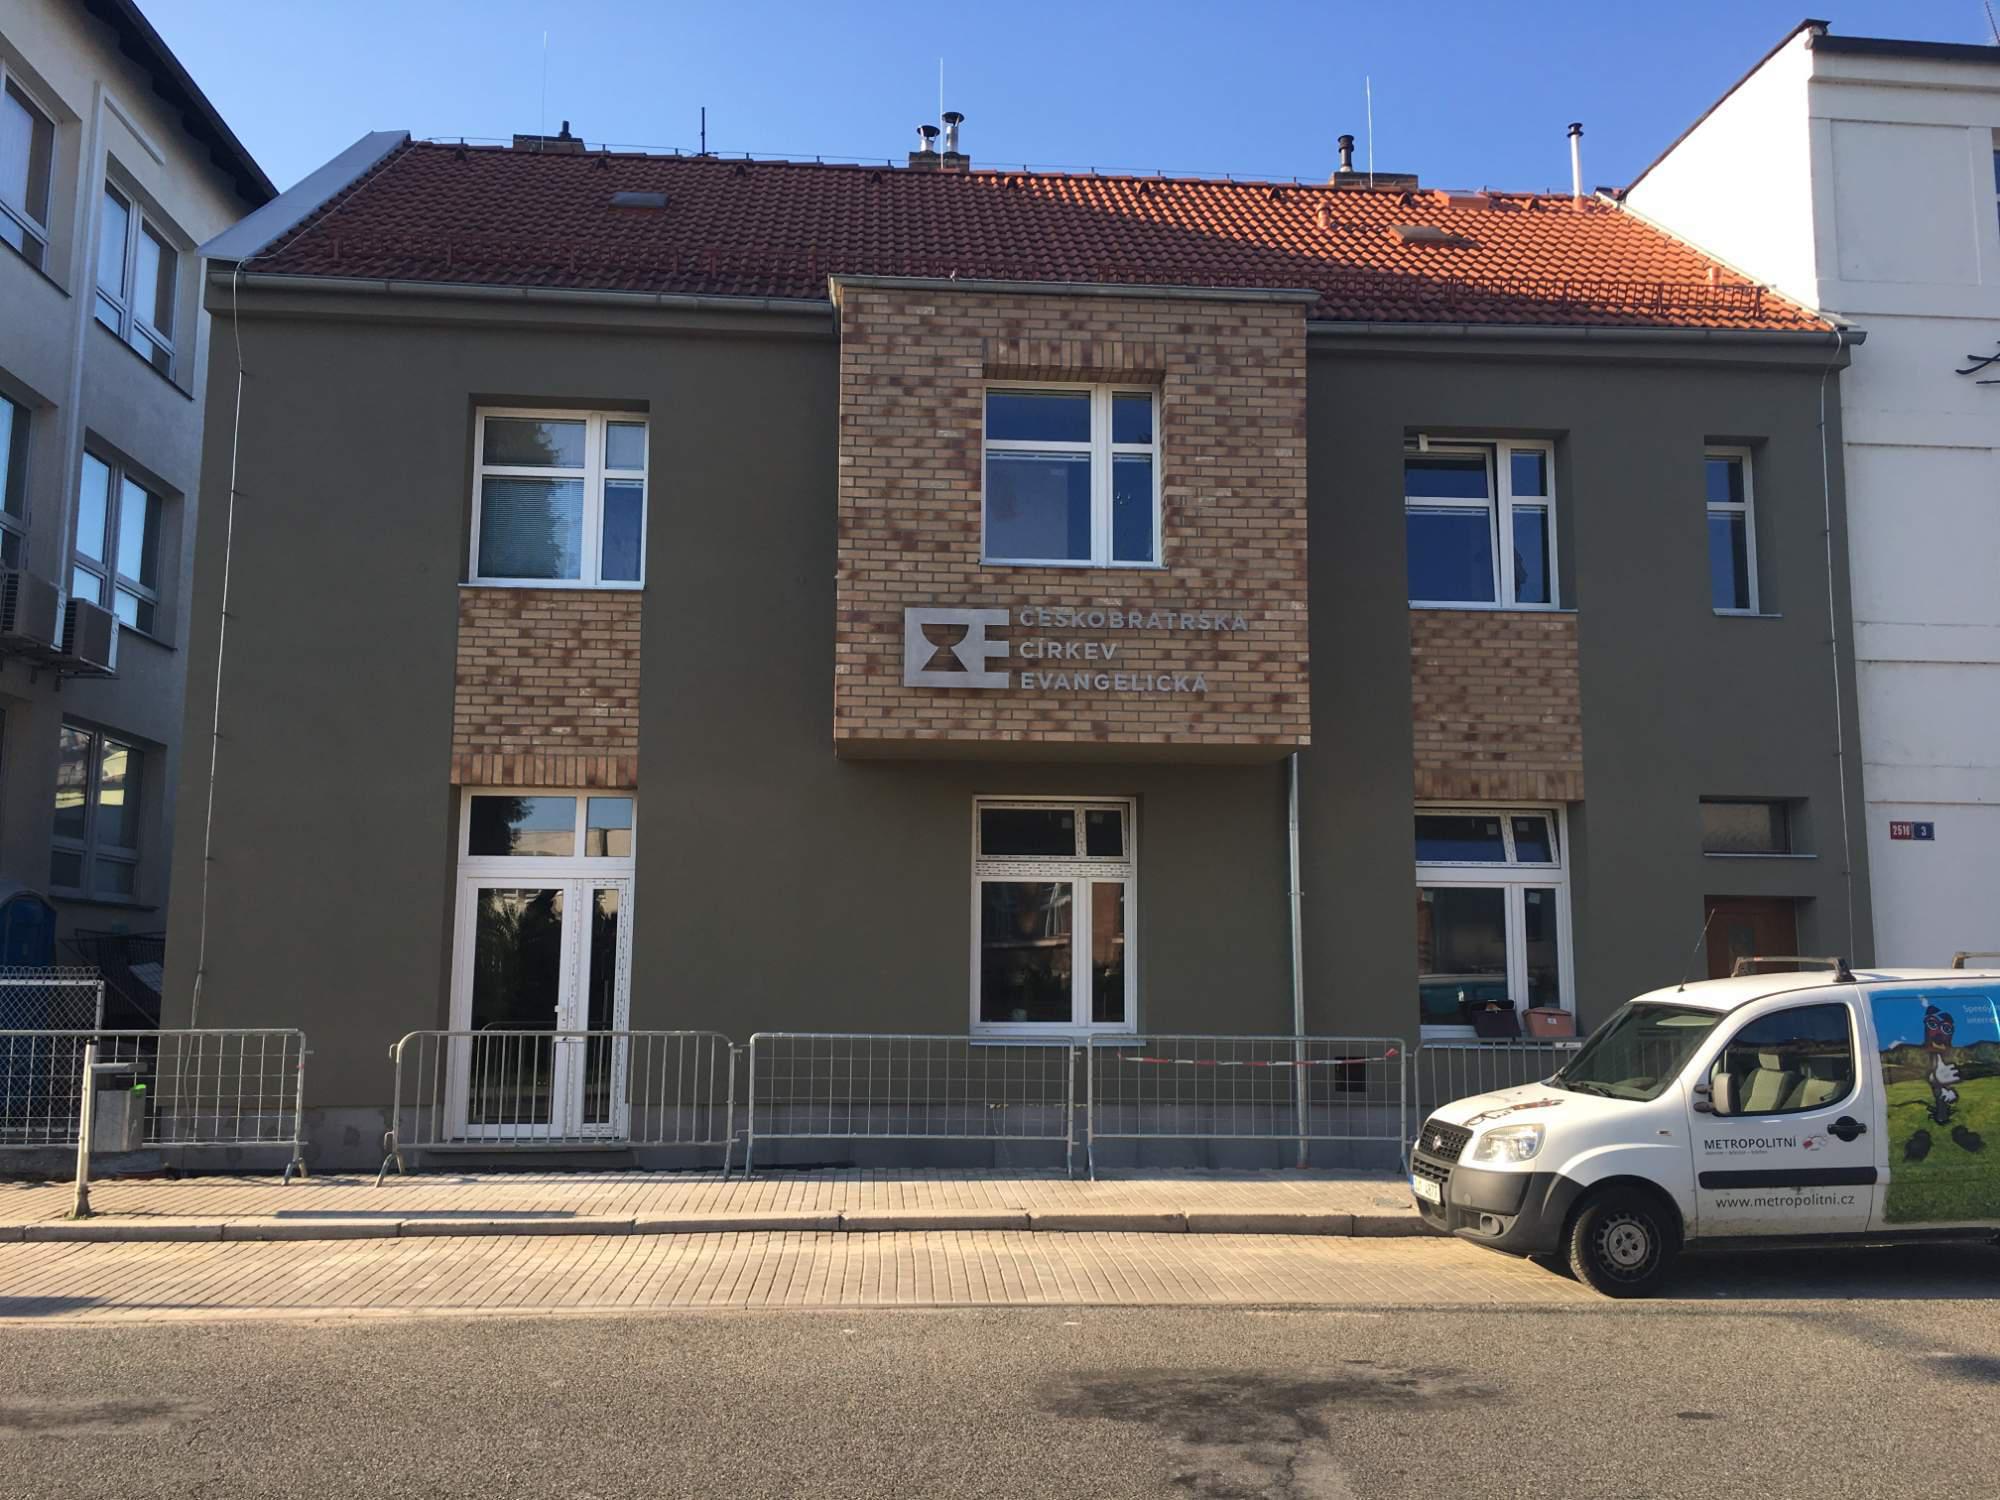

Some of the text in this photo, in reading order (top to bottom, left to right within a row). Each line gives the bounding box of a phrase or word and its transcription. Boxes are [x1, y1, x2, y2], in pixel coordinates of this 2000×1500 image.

[1019, 605, 1248, 631] ČESKOBRATRSKÁ
[1019, 638, 1118, 660] CÍRKEV
[1020, 672, 1209, 692] EVANGELICKÁ
[1920, 825, 1927, 836] 3
[1704, 1136, 1797, 1150] METROPOLITNÍ
[1715, 1192, 1856, 1209] www.metropolitni.cz
